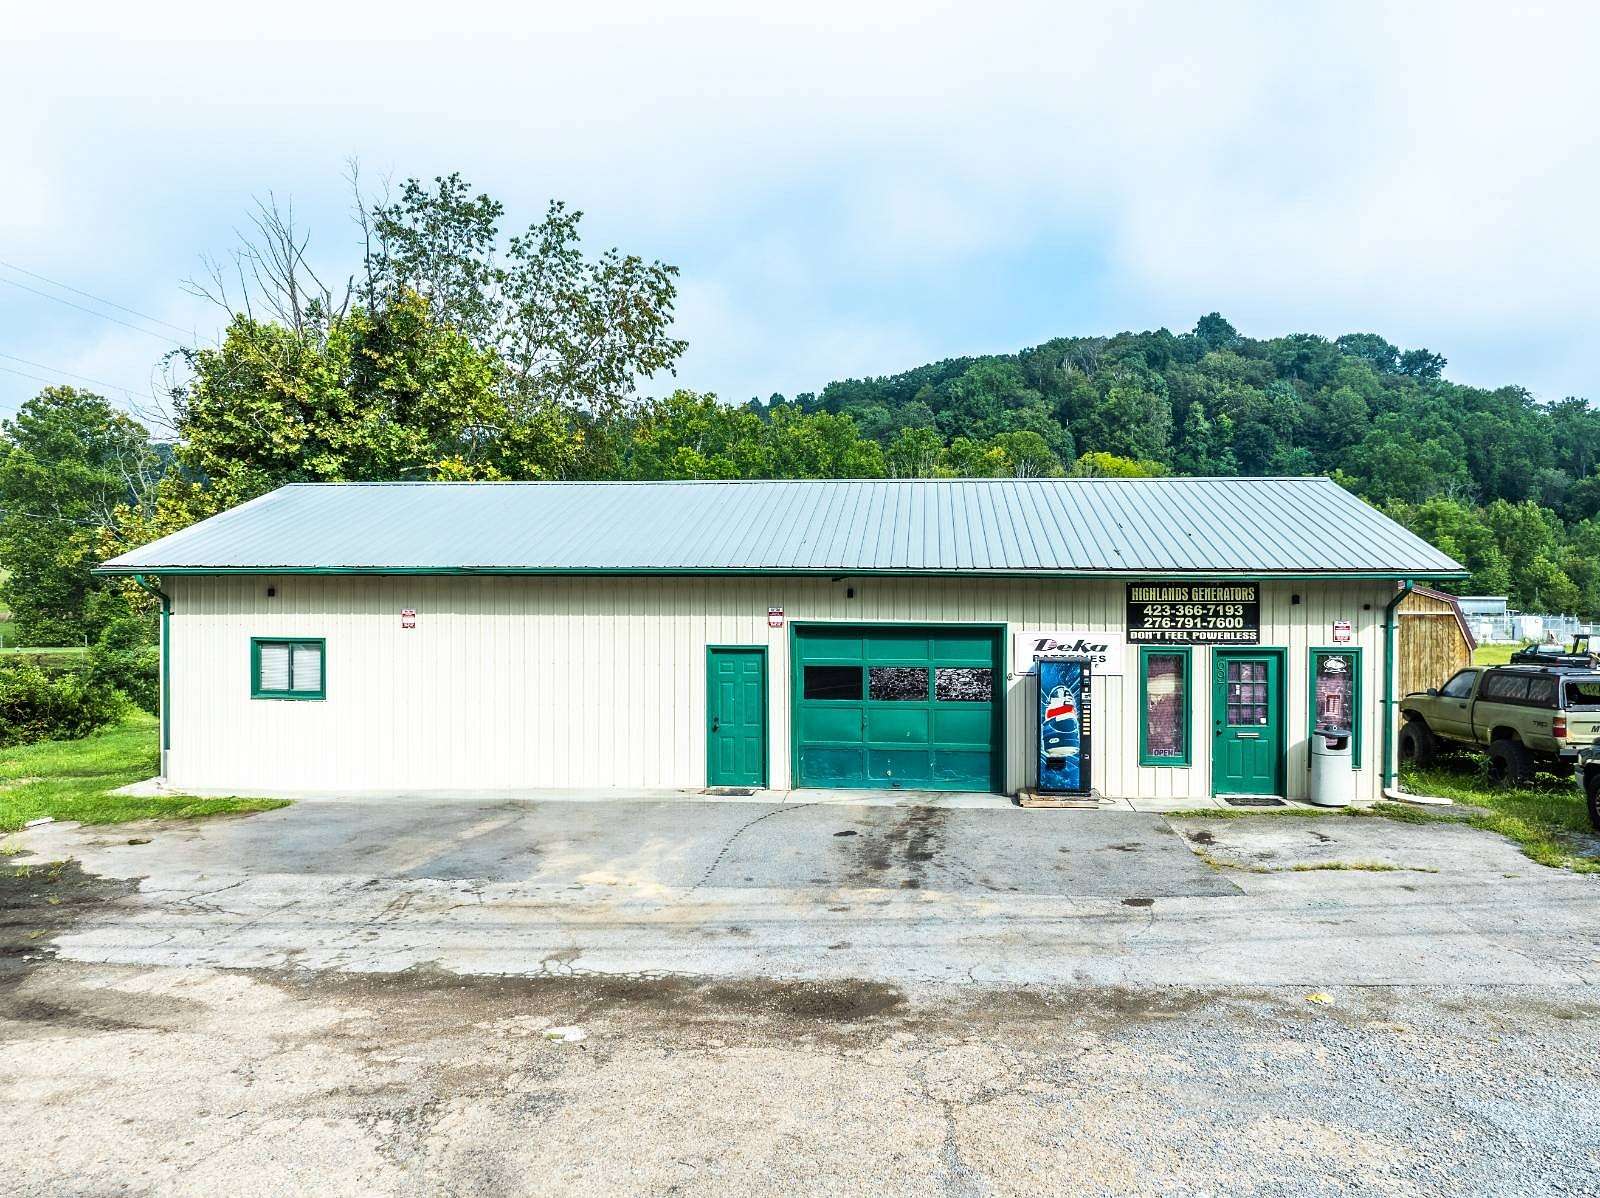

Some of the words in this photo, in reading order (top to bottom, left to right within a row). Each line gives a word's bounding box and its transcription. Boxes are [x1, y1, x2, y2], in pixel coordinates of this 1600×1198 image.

[1132, 587, 1188, 601] HIGHLANDS
[1191, 587, 1255, 601] GENERATORS
[1143, 604, 1243, 616] 423-366-7193
[1143, 617, 1243, 628] 276-791-7600
[1130, 631, 1163, 640] DON'T
[1165, 631, 1189, 640] FEEL
[1192, 631, 1257, 640] POWERLESS
[1033, 638, 1108, 653] Deka
